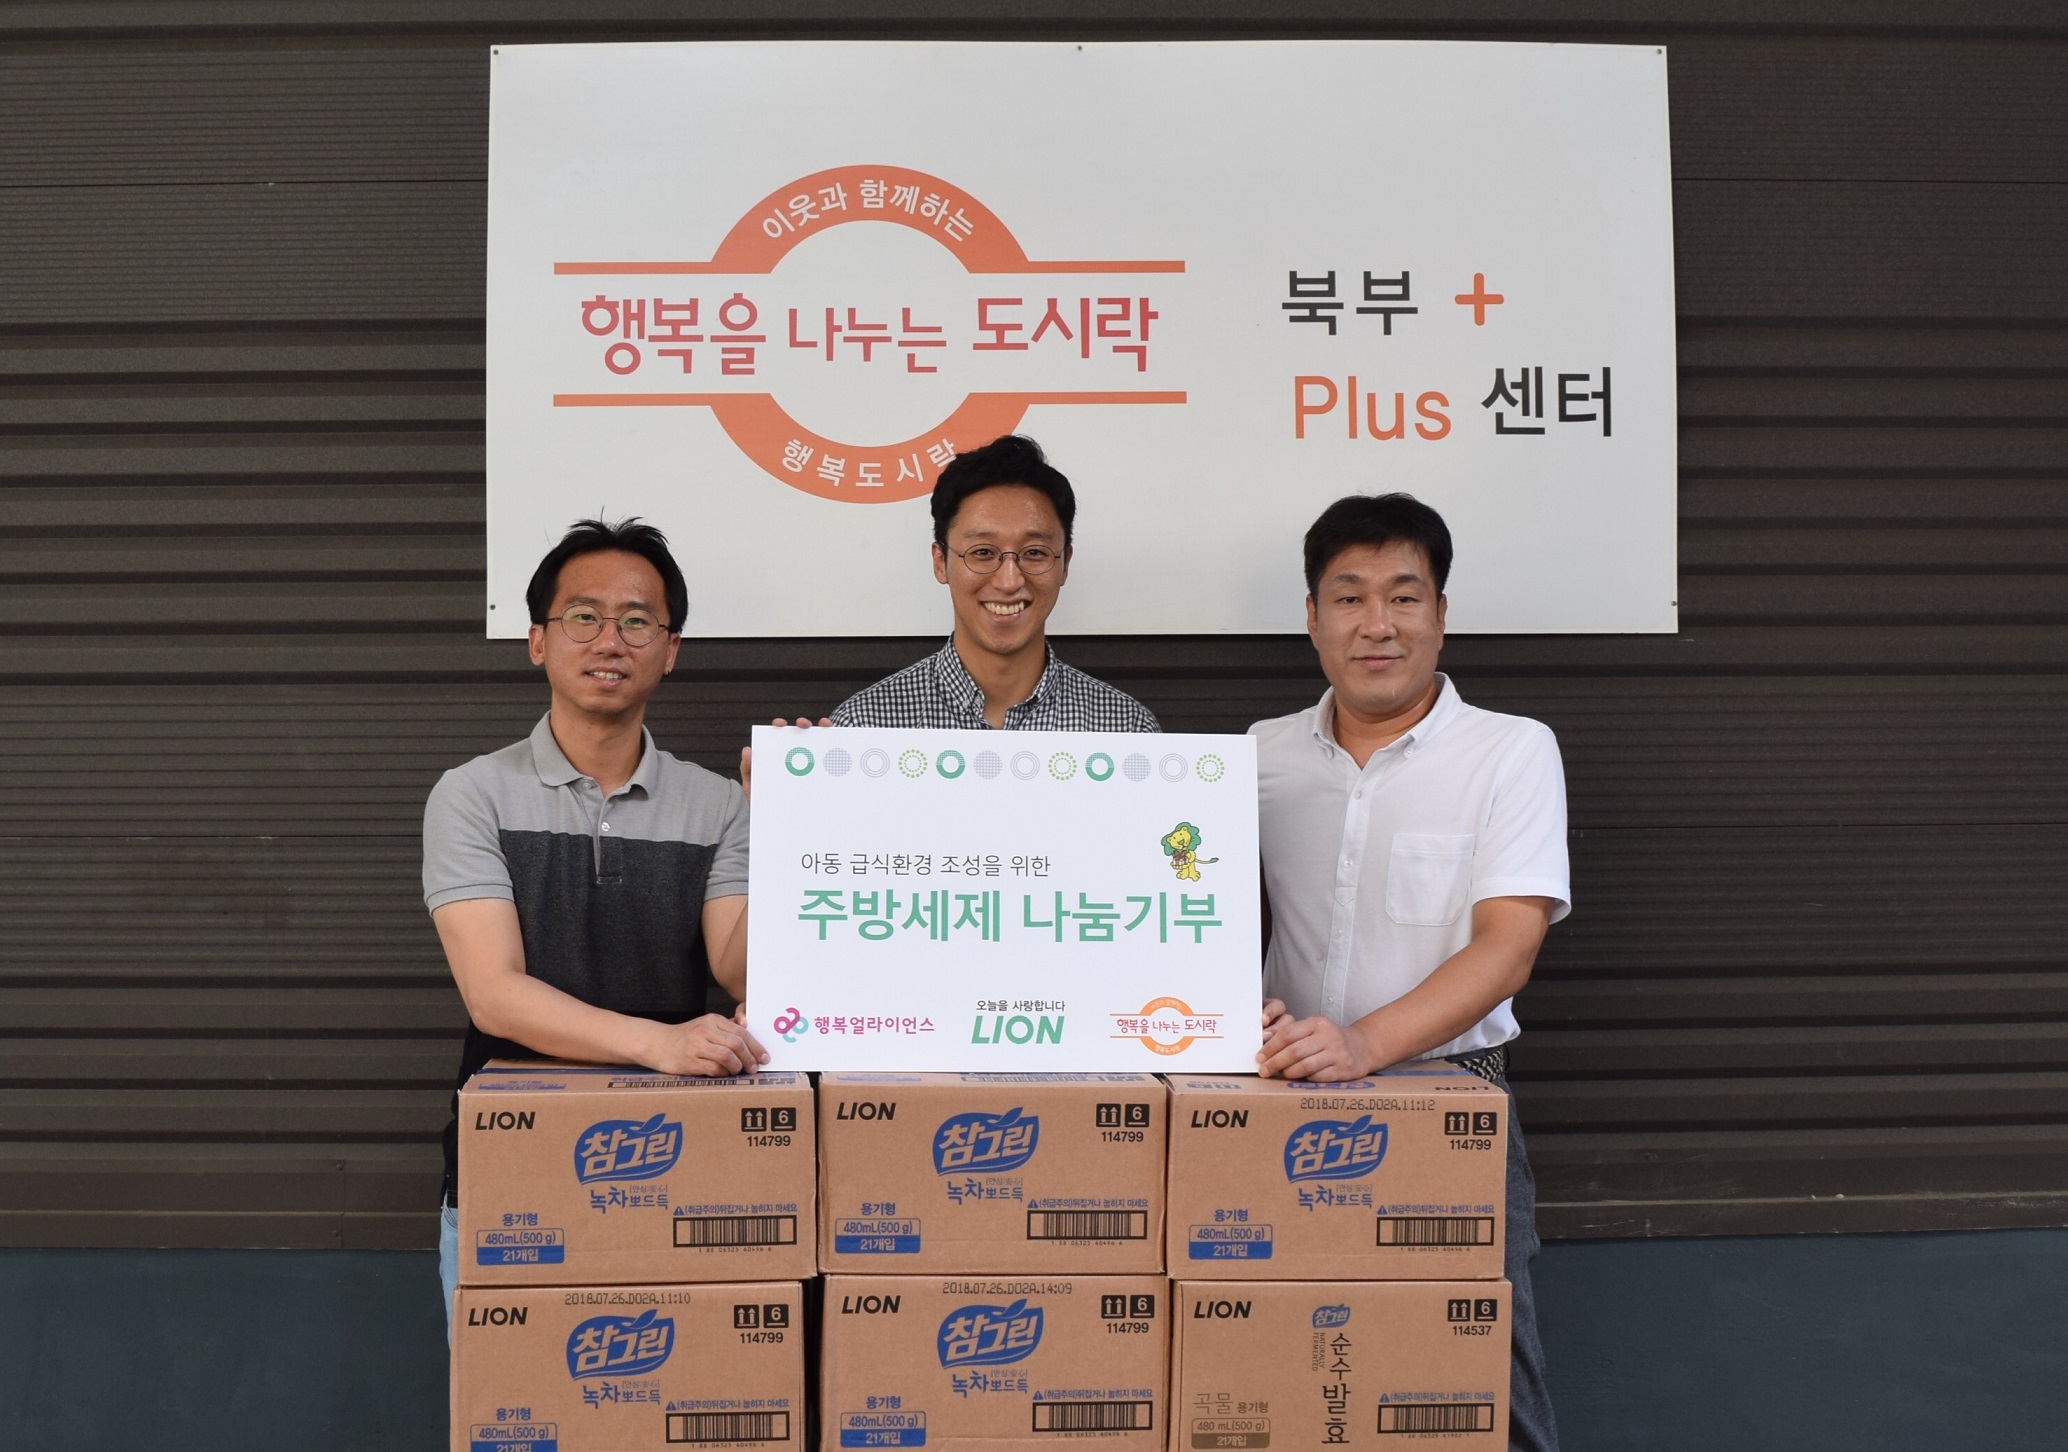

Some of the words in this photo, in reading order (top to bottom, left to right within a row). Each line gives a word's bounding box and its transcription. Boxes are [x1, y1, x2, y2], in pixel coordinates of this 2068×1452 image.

[762, 183, 847, 241] 이웃과
[858, 180, 974, 242] 함께하는
[1281, 270, 1418, 335] 북부
[581, 292, 767, 375] 행복을
[787, 307, 947, 373] 나누는
[972, 297, 1159, 373] 도시락
[1294, 375, 1451, 440] Plus
[1481, 366, 1611, 437] 센터
[801, 852, 841, 875] 아동
[850, 853, 932, 876] 급식환경
[941, 854, 1003, 877] 조성을
[1010, 855, 1050, 878] 위한
[798, 889, 1001, 942] 주방세제
[1023, 891, 1223, 943] 나눔기부
[976, 1000, 1009, 1011] 오늘을
[1012, 1000, 1065, 1012] 사랑합니다
[814, 1015, 935, 1035] 행복얼라이언스
[971, 1015, 1065, 1044] LION
[1117, 1018, 1149, 1034] 행복을
[1152, 1021, 1180, 1033] 나누는
[1184, 1019, 1217, 1034] 도시락
[778, 1110, 789, 1124] 6
[836, 1102, 896, 1120] LION
[1132, 1106, 1142, 1120] 6
[475, 1111, 536, 1131] LION
[1191, 1110, 1249, 1128] LION
[1480, 1114, 1490, 1128] 6
[746, 1135, 791, 1147] 114799
[1101, 1131, 1144, 1143] 114799
[939, 1121, 1034, 1168] 참그린
[1449, 1139, 1491, 1151] 114799
[580, 1128, 677, 1177] 참그린
[1290, 1129, 1383, 1175] 참그린
[860, 1203, 896, 1216] 용기형
[1214, 1209, 1248, 1222] 용기형
[502, 1213, 539, 1226] 용기형
[860, 1238, 895, 1251] 21개입
[1213, 1244, 1248, 1257] 21개입
[503, 1249, 539, 1262] 21개입
[841, 1296, 901, 1314] LION
[1138, 1298, 1148, 1311] 6
[1193, 1300, 1252, 1318] LION
[1481, 1301, 1491, 1314] 6
[468, 1307, 528, 1326] LION
[771, 1307, 781, 1321] 6
[1315, 1310, 1349, 1326] 참그린
[1106, 1322, 1149, 1334] 114799
[1452, 1325, 1492, 1336] 114537
[740, 1332, 784, 1344] 114799
[943, 1314, 1038, 1361] 참그린
[573, 1325, 668, 1373] 참그린
[866, 1396, 901, 1409] 용기형
[1193, 1392, 1234, 1414] 곡물
[1237, 1401, 1269, 1414] 용기형
[496, 1408, 531, 1421] 용기형
[865, 1432, 900, 1445] 21개입
[1217, 1435, 1247, 1447] 21개입
